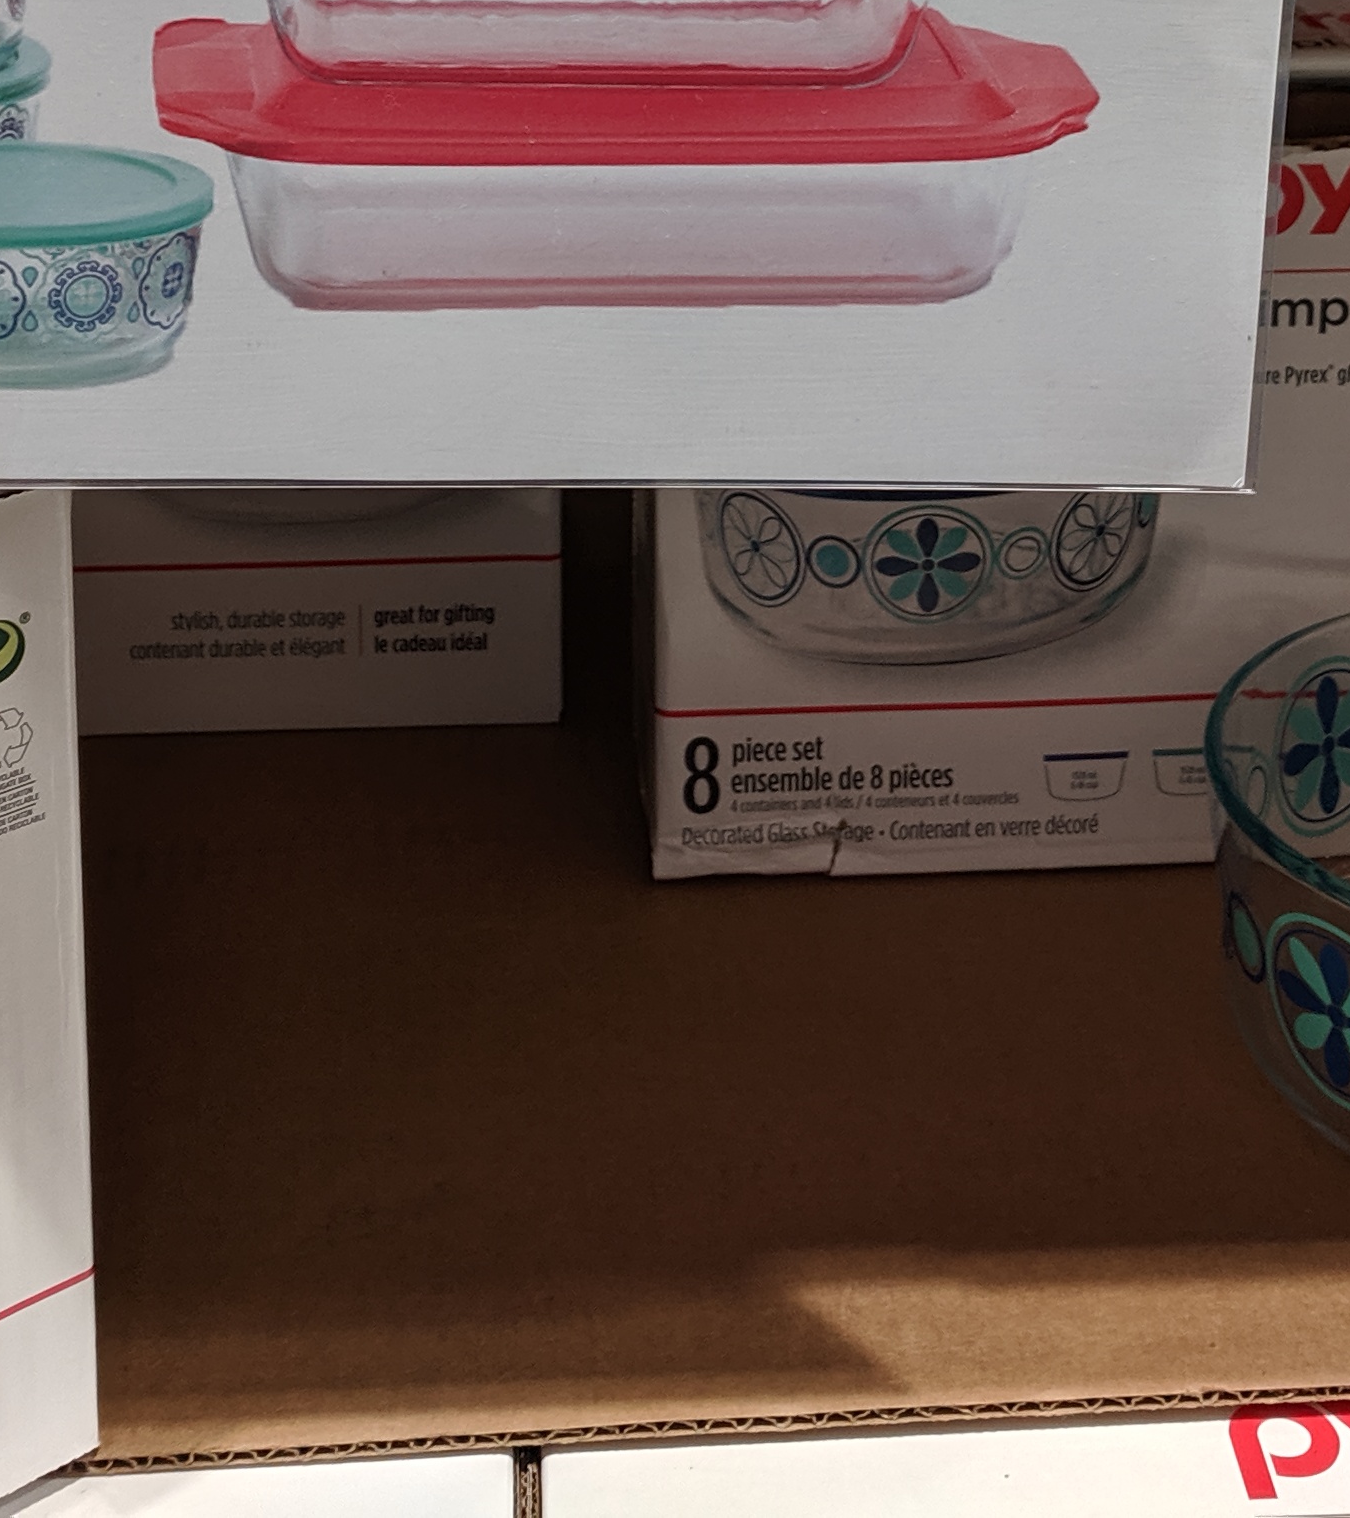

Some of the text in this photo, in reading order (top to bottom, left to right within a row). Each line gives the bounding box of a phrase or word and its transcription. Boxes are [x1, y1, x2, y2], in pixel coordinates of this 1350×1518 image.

[373, 603, 496, 629] great for gifting
[731, 738, 825, 768] piece set
[682, 735, 721, 815] 8
[730, 762, 954, 794] ensemble de 8 pièces
